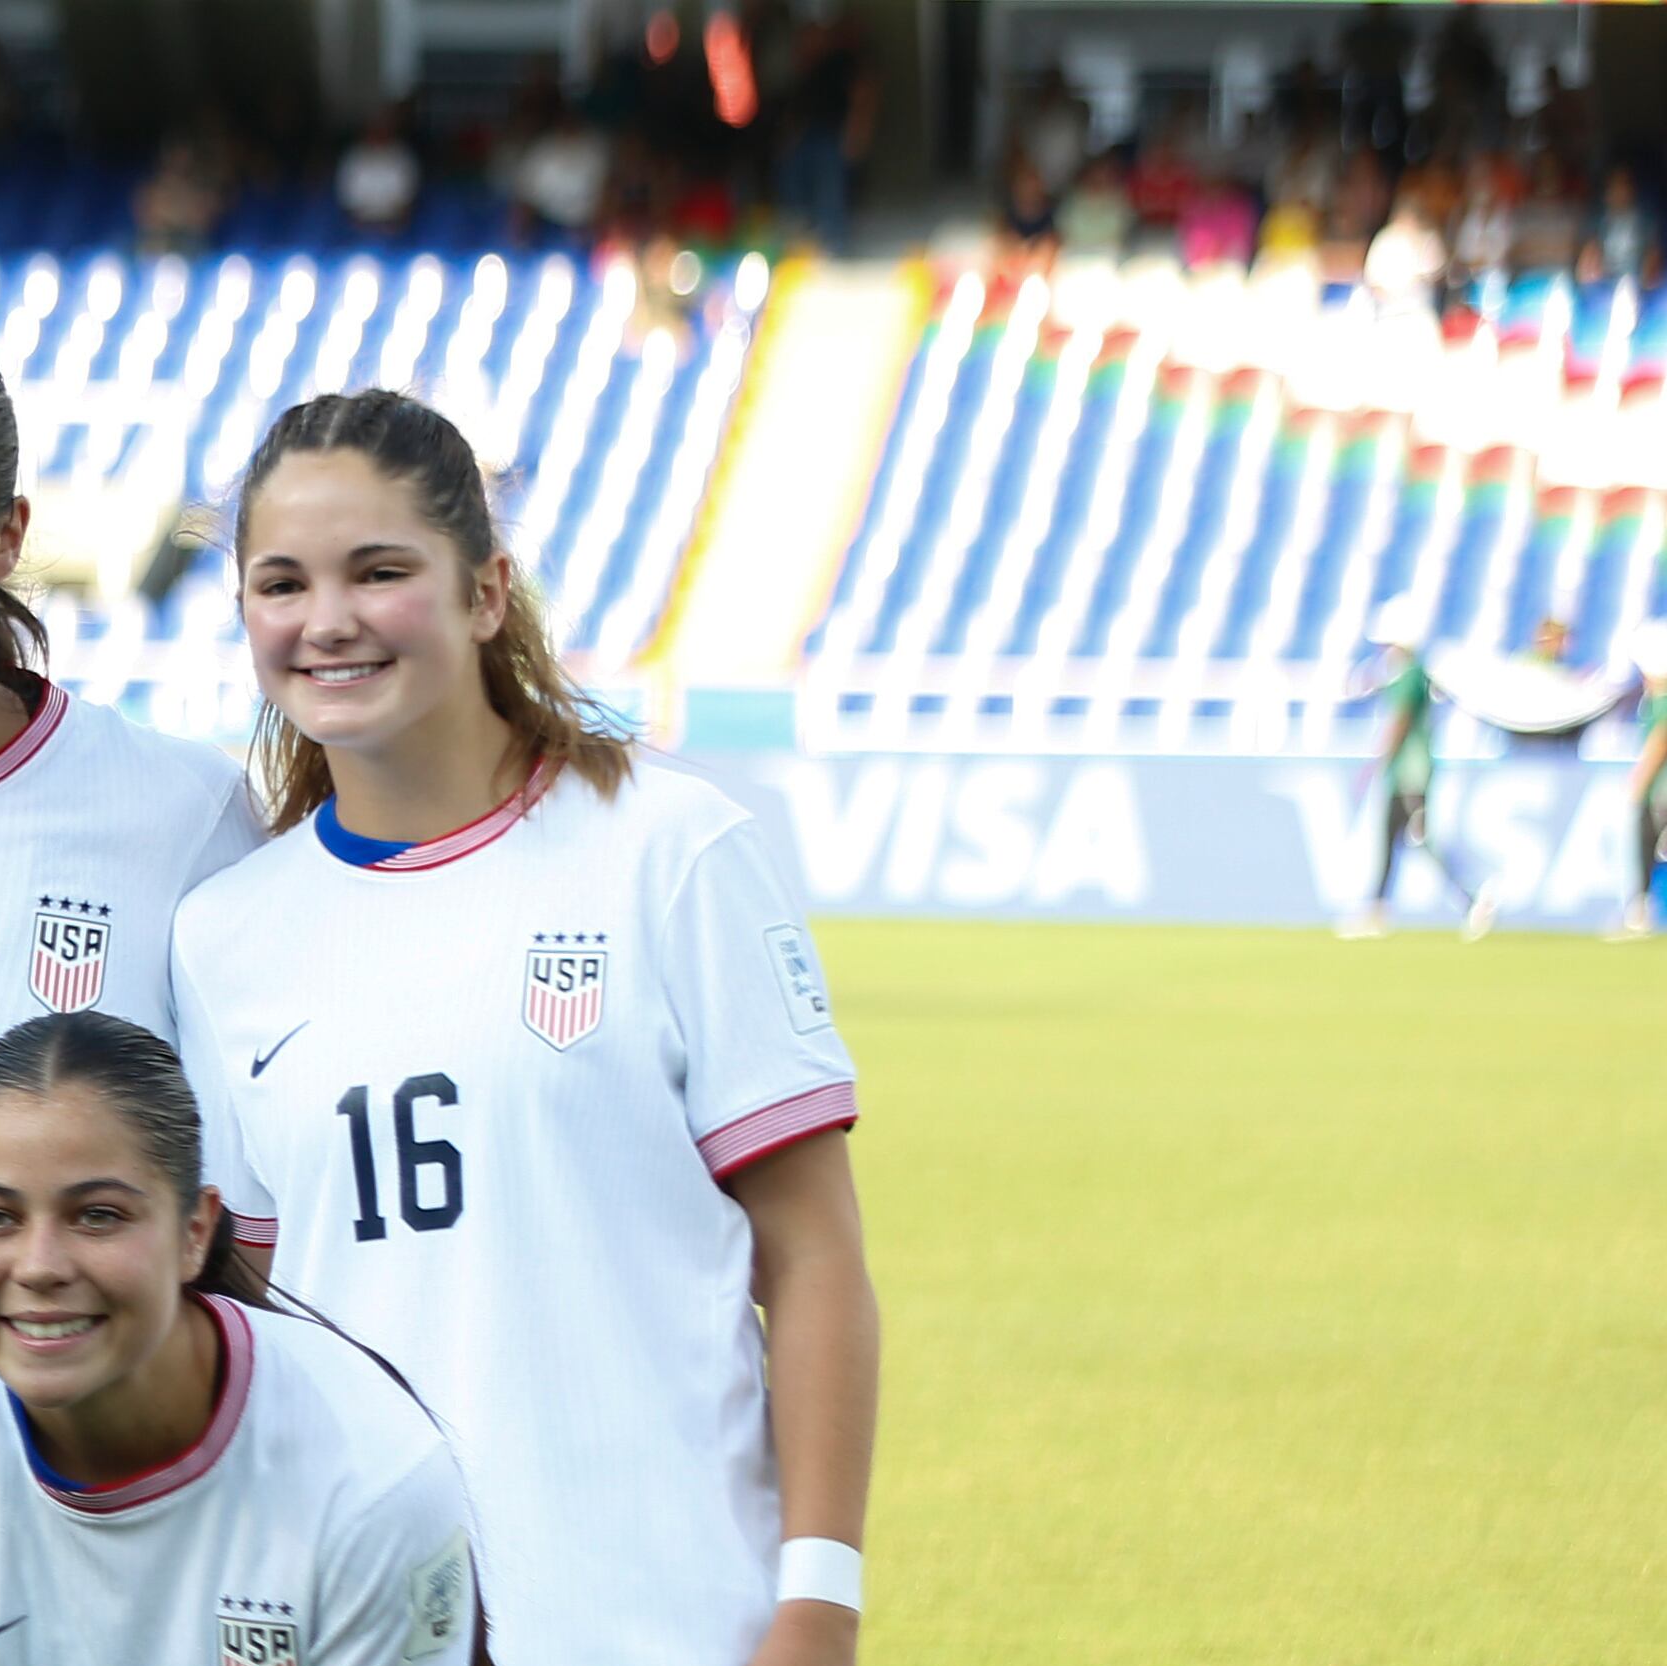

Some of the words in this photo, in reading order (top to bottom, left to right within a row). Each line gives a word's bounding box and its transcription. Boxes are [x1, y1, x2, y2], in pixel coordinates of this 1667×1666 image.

[770, 757, 1147, 906] VISA
[40, 921, 103, 961] USA
[533, 957, 600, 992] USA
[336, 1072, 463, 1242] 16
[224, 1624, 292, 1666] USA
